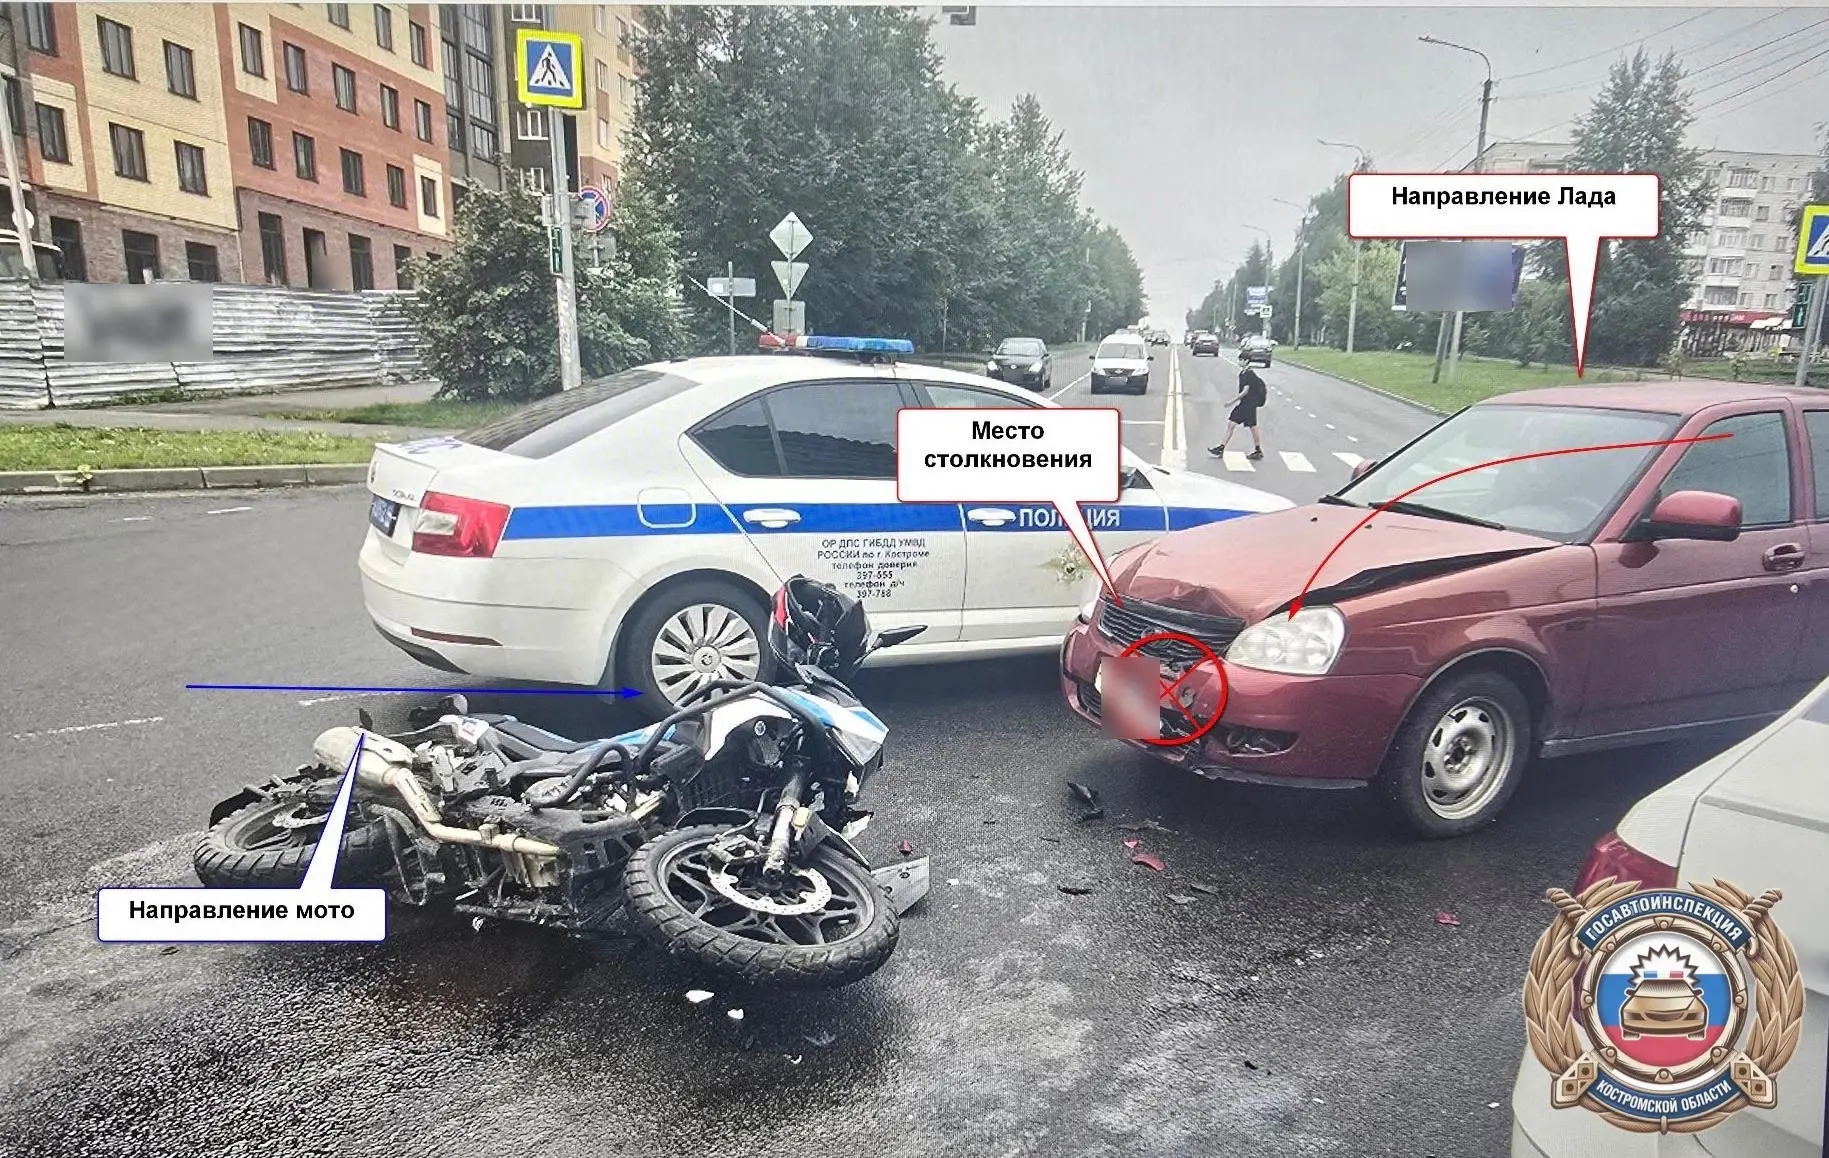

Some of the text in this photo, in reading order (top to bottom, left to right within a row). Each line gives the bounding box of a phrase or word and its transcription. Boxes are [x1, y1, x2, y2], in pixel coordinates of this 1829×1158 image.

[822, 537, 926, 549] ОР ДПС ГИБДД УМВД
[817, 550, 860, 560] РОССИИ
[862, 551, 874, 560] по
[884, 550, 930, 559] Костроме
[832, 561, 918, 571] телефон доверия
[844, 580, 886, 590] телефон
